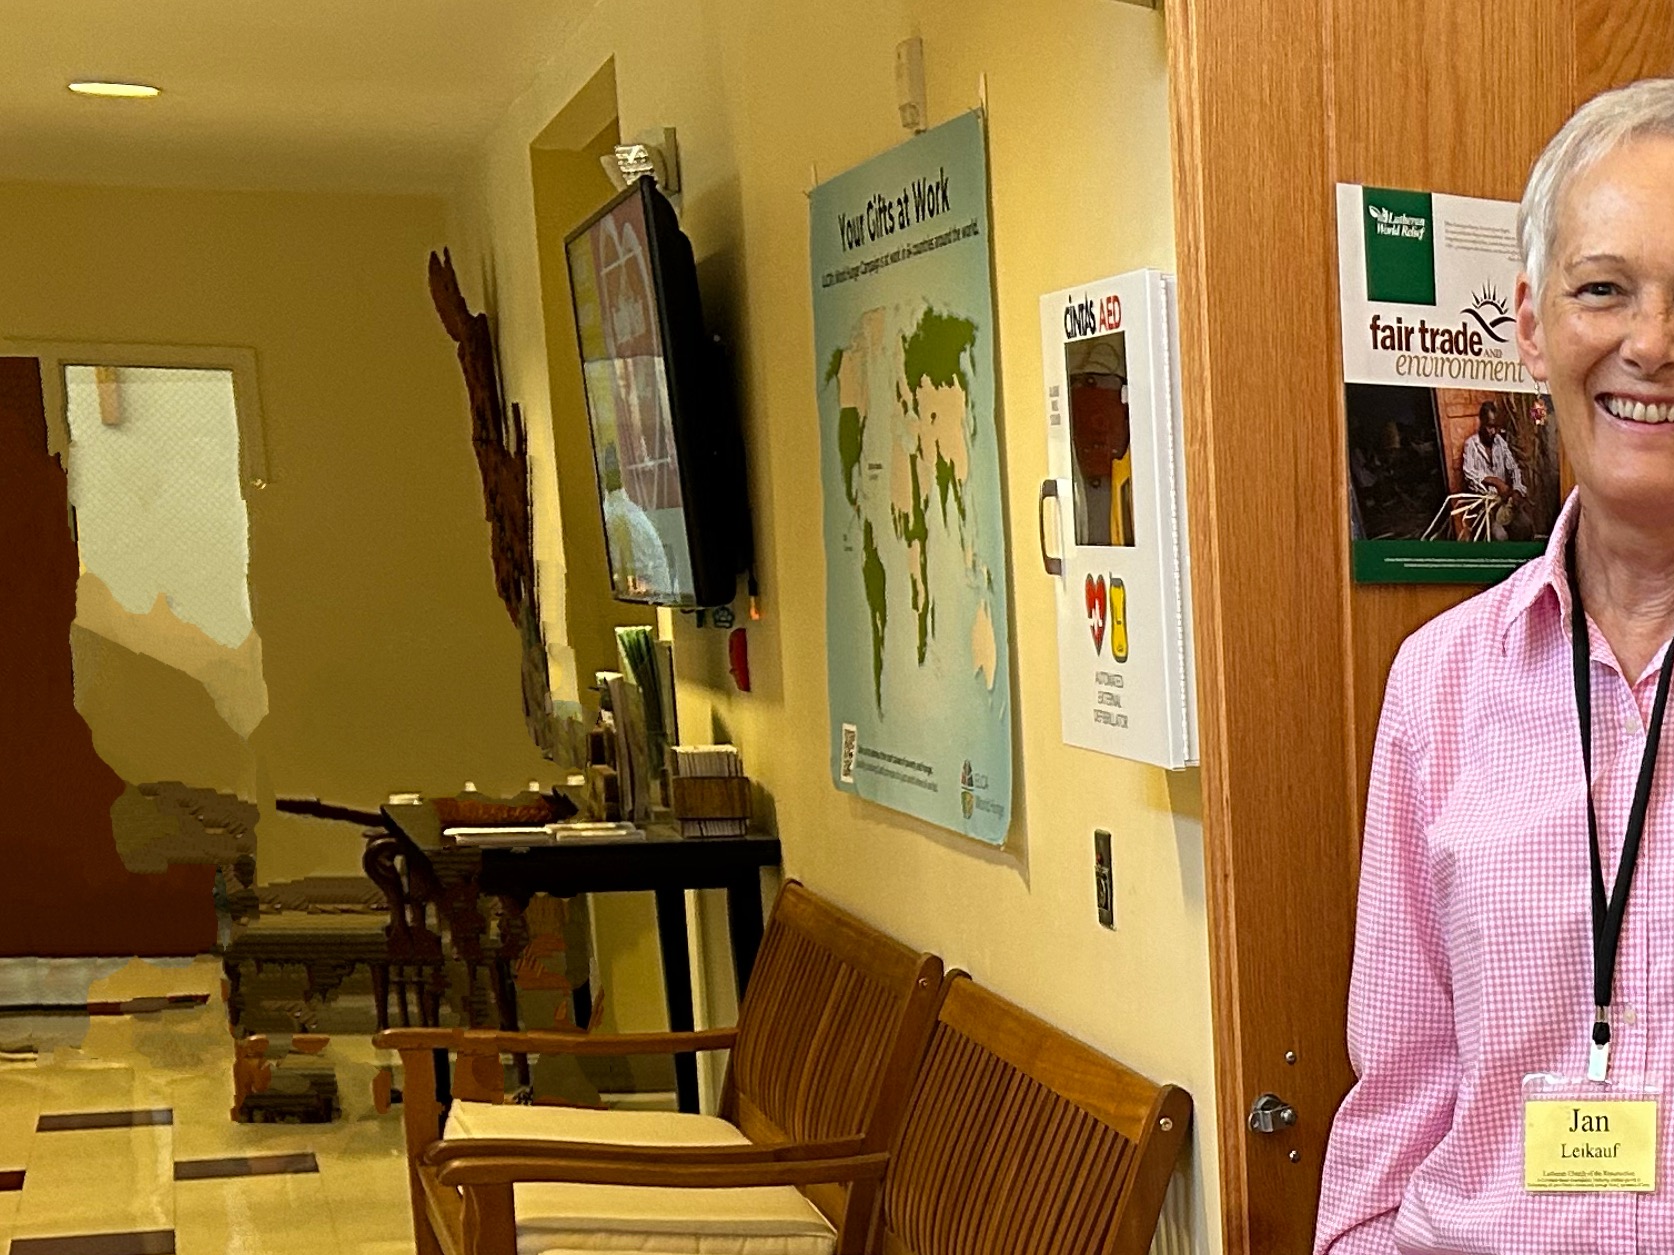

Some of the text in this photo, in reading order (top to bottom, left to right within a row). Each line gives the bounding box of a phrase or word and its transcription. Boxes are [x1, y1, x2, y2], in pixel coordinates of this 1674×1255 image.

[838, 166, 950, 252] Your Gifts at Work
[1377, 223, 1425, 241] World Relief
[1099, 294, 1122, 333] AED
[1370, 314, 1502, 358] fair trade AND
[1396, 352, 1525, 383] environment
[1569, 1108, 1610, 1132] Jan
[1561, 1143, 1621, 1158] Leikauf
